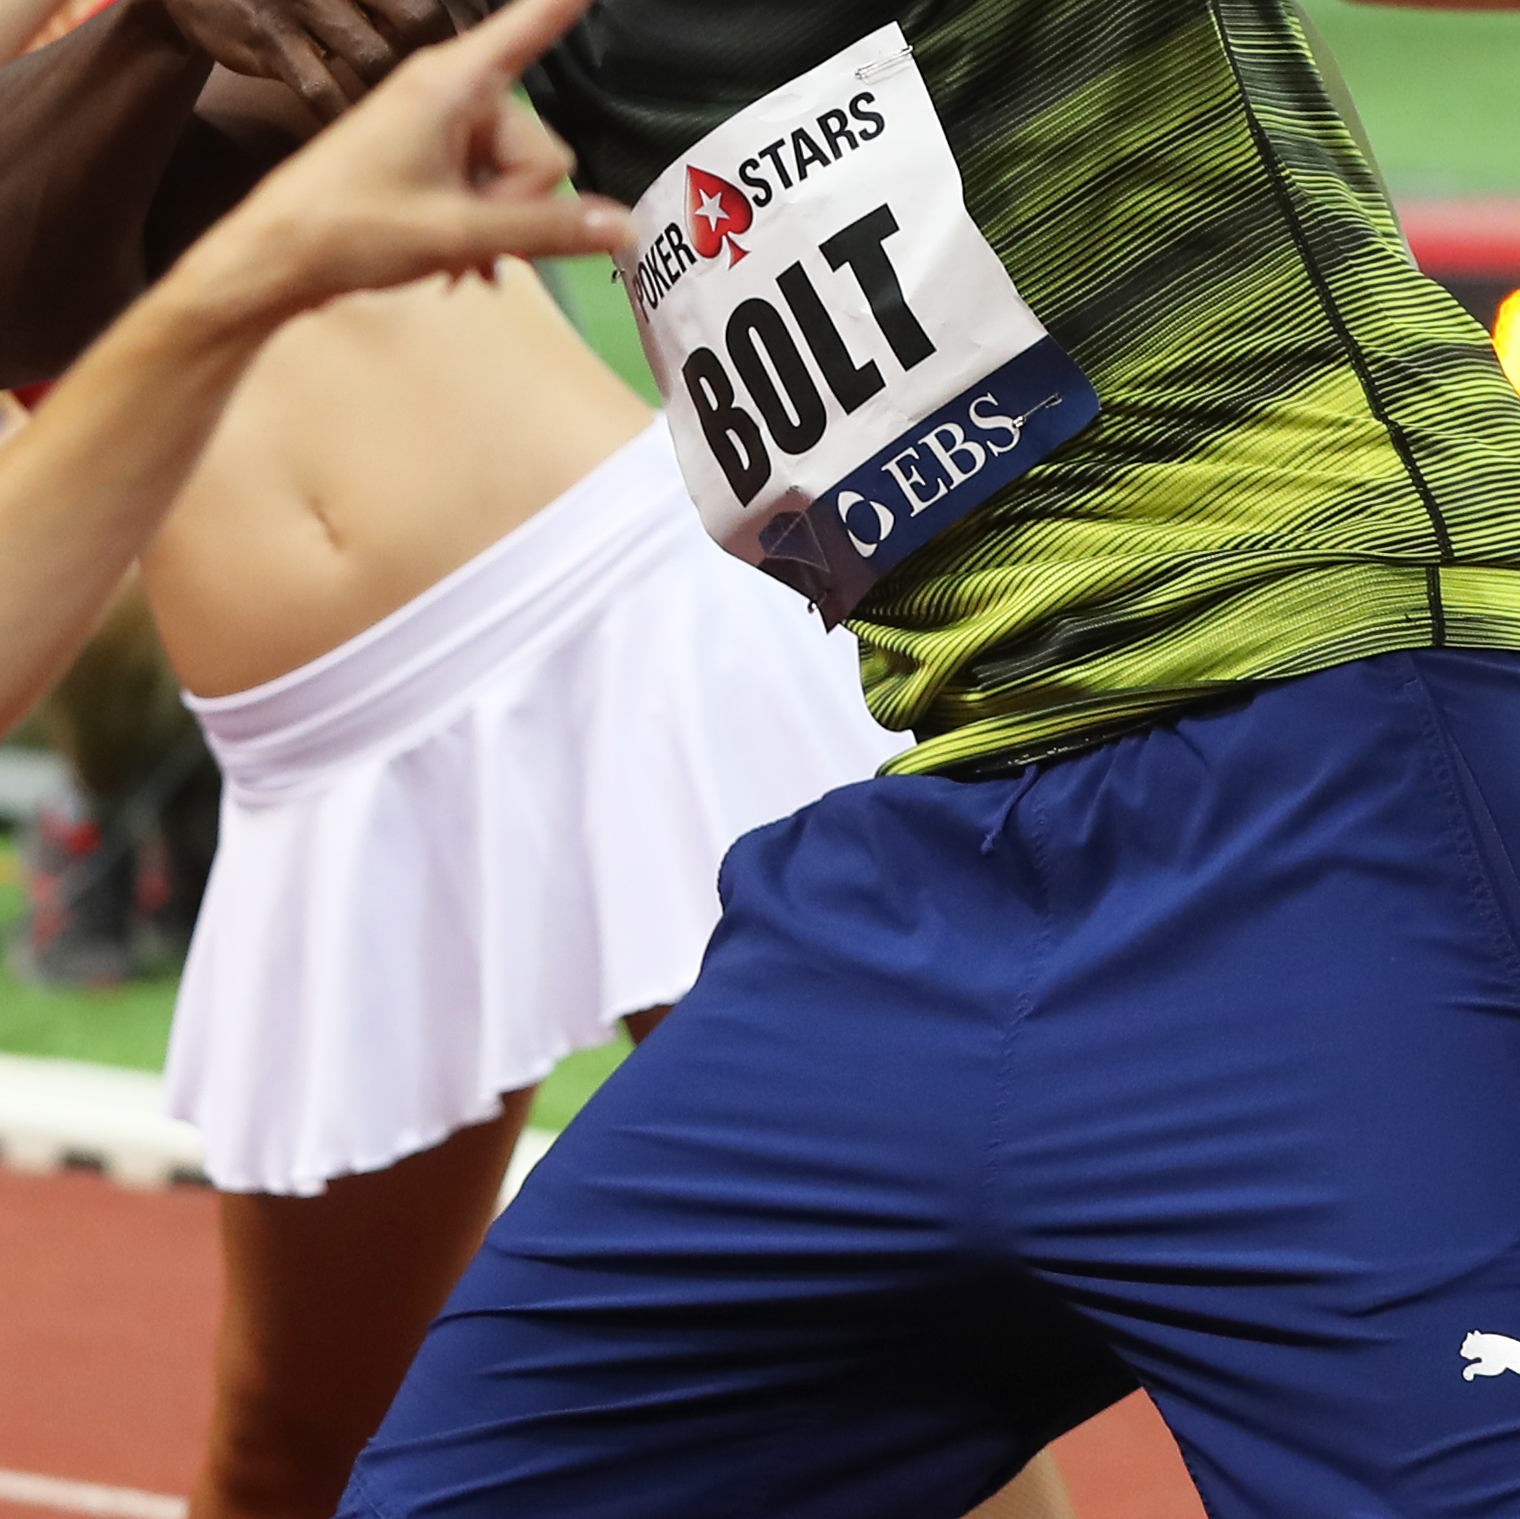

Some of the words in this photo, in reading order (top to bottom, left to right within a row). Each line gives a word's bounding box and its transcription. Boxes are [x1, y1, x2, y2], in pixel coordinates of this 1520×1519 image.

[634, 222, 697, 323] POKER
[740, 92, 885, 207] STARS
[683, 204, 935, 506] BOLT
[882, 393, 1021, 518] EBS
